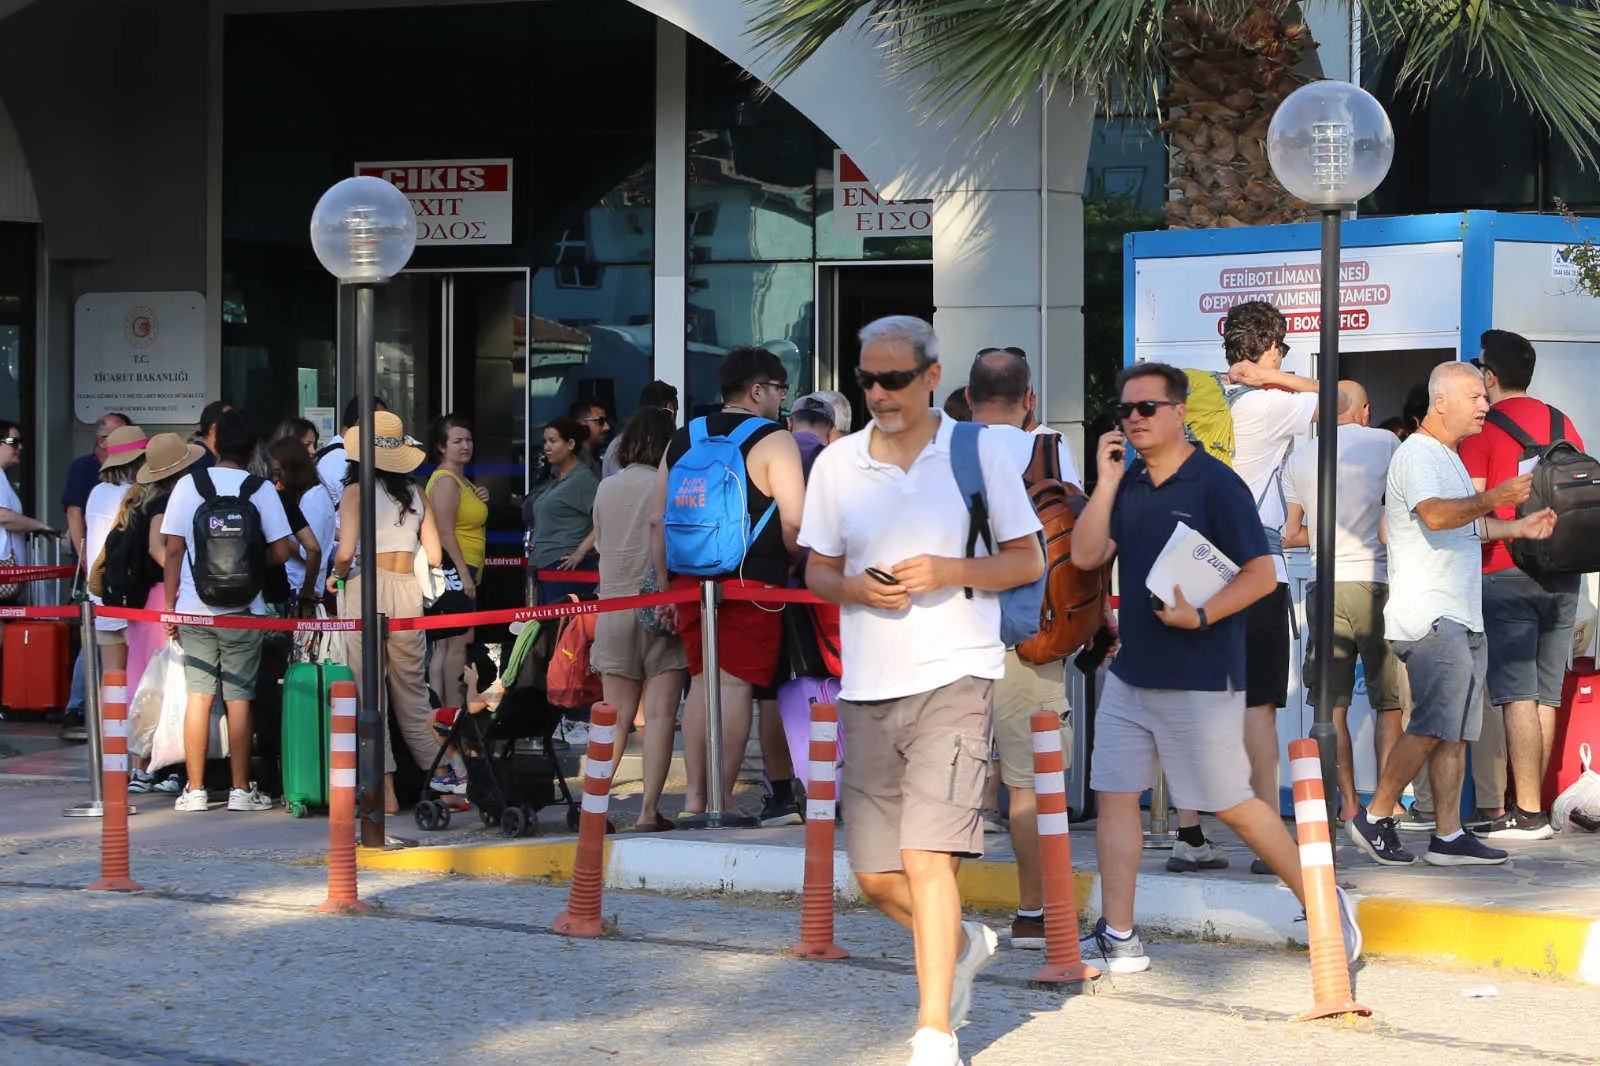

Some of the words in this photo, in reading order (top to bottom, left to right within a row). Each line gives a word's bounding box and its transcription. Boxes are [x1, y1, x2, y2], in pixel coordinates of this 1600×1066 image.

[856, 210, 931, 230] ΕΙΣΟ
[1223, 269, 1272, 288] FERİBOT
[1275, 264, 1314, 284] LİMAN
[94, 371, 134, 382] TİCARET
[136, 369, 188, 382] BAKANLIĞI
[675, 493, 706, 507] NIKE
[514, 605, 552, 619] AYVALIK
[297, 621, 322, 631] AYVALIK
[322, 619, 356, 631] BELEDİYESİ
